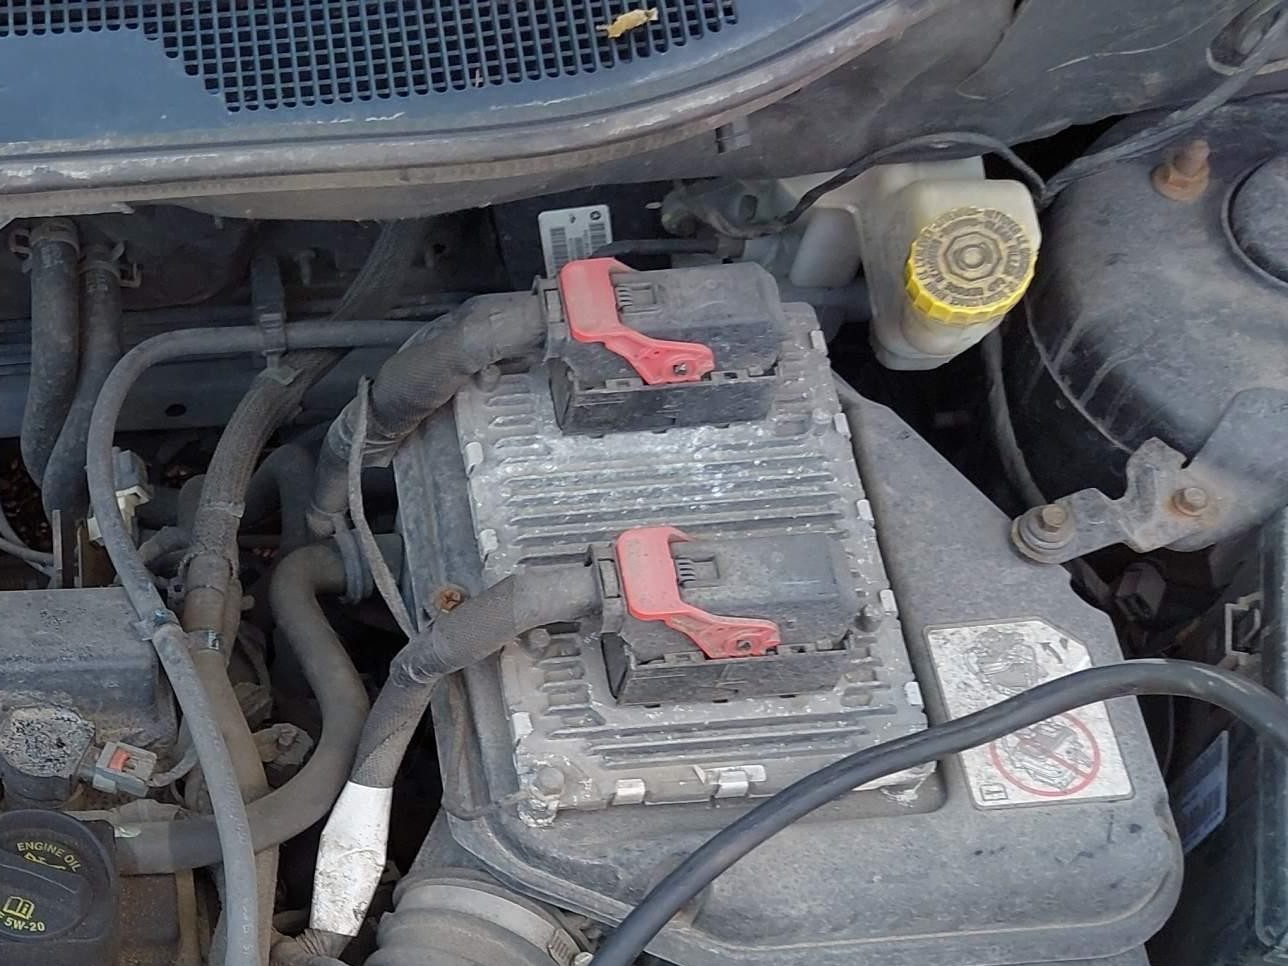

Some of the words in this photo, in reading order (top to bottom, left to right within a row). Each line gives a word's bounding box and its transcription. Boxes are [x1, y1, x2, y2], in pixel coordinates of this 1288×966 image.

[16, 840, 65, 858] ENGINE
[63, 853, 81, 872] OIL
[4, 916, 45, 932] 5W-20
